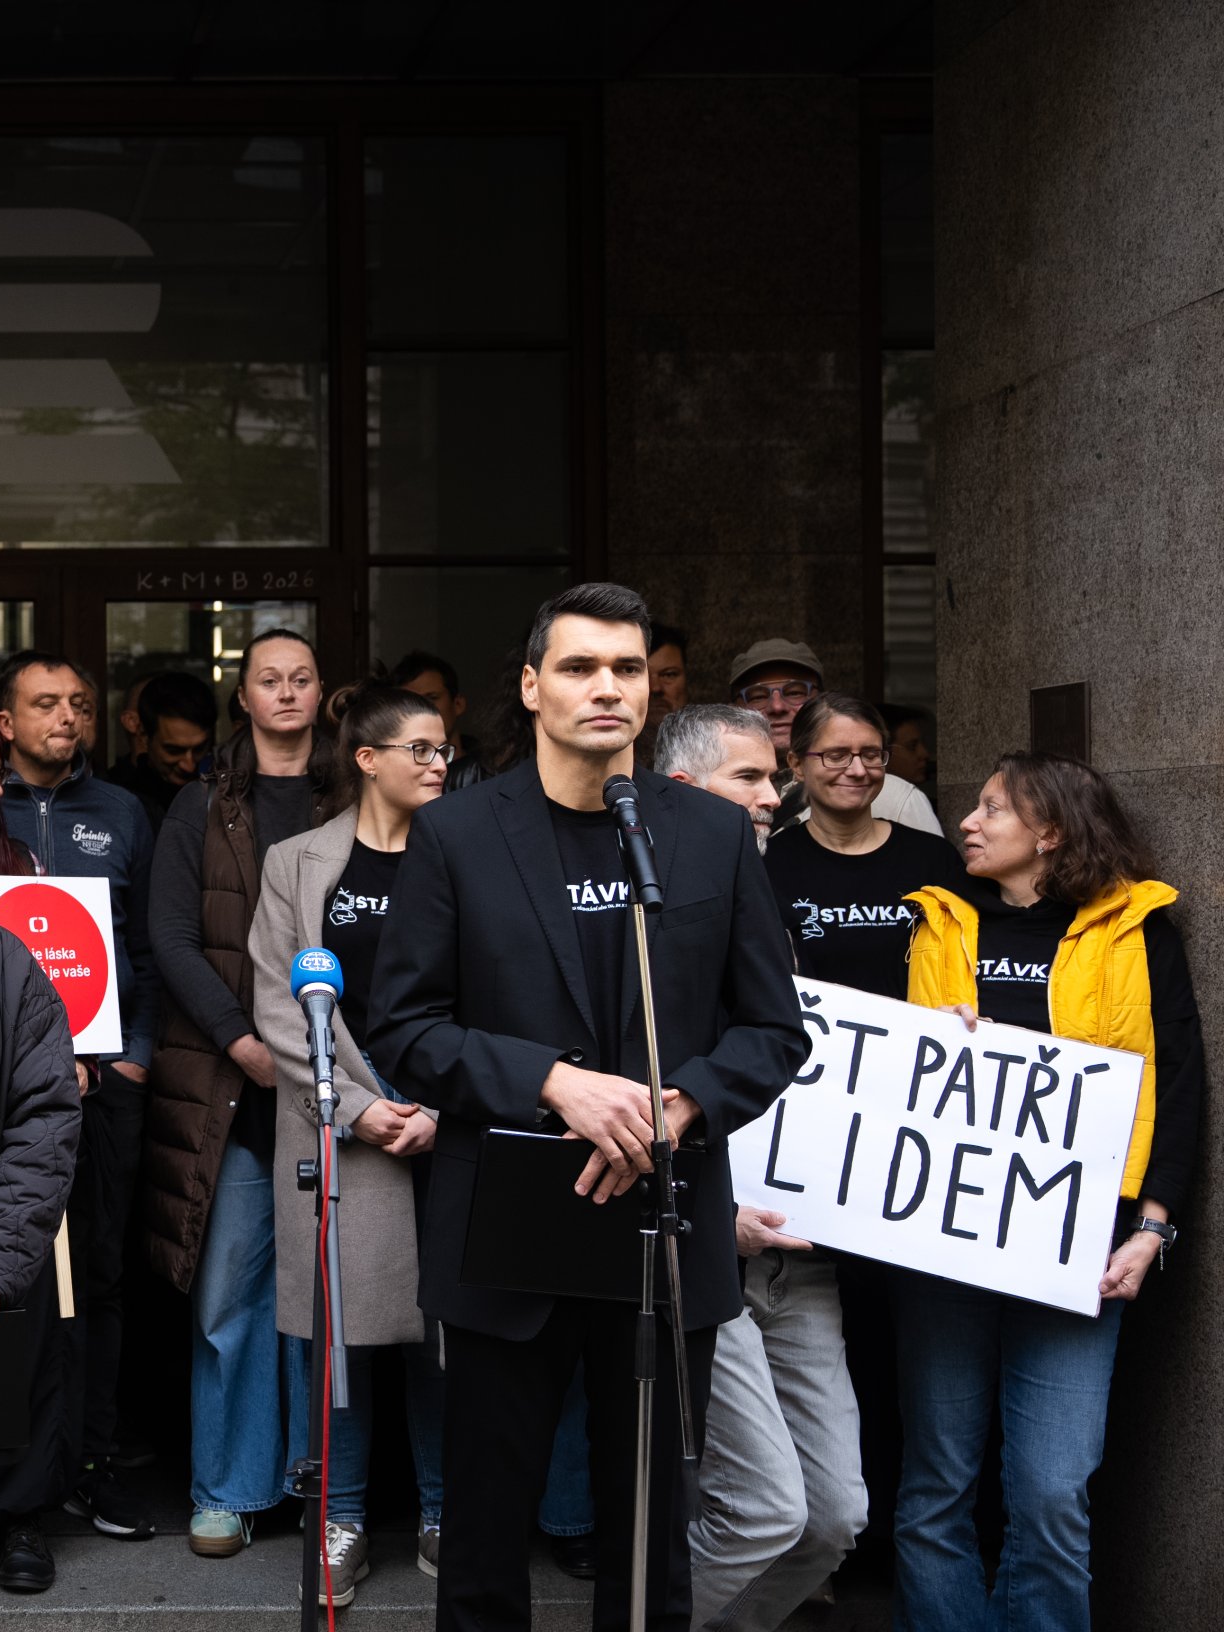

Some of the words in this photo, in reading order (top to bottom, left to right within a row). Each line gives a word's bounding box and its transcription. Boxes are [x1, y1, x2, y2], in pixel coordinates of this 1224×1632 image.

[820, 903, 912, 923] STÁVKA
[45, 947, 76, 960] láska
[49, 966, 61, 981] je
[63, 964, 90, 977] vaše
[976, 957, 1051, 978] TÁVK
[907, 1035, 1111, 1151] PATŘÍ
[764, 1098, 1083, 1266] LIDEM
